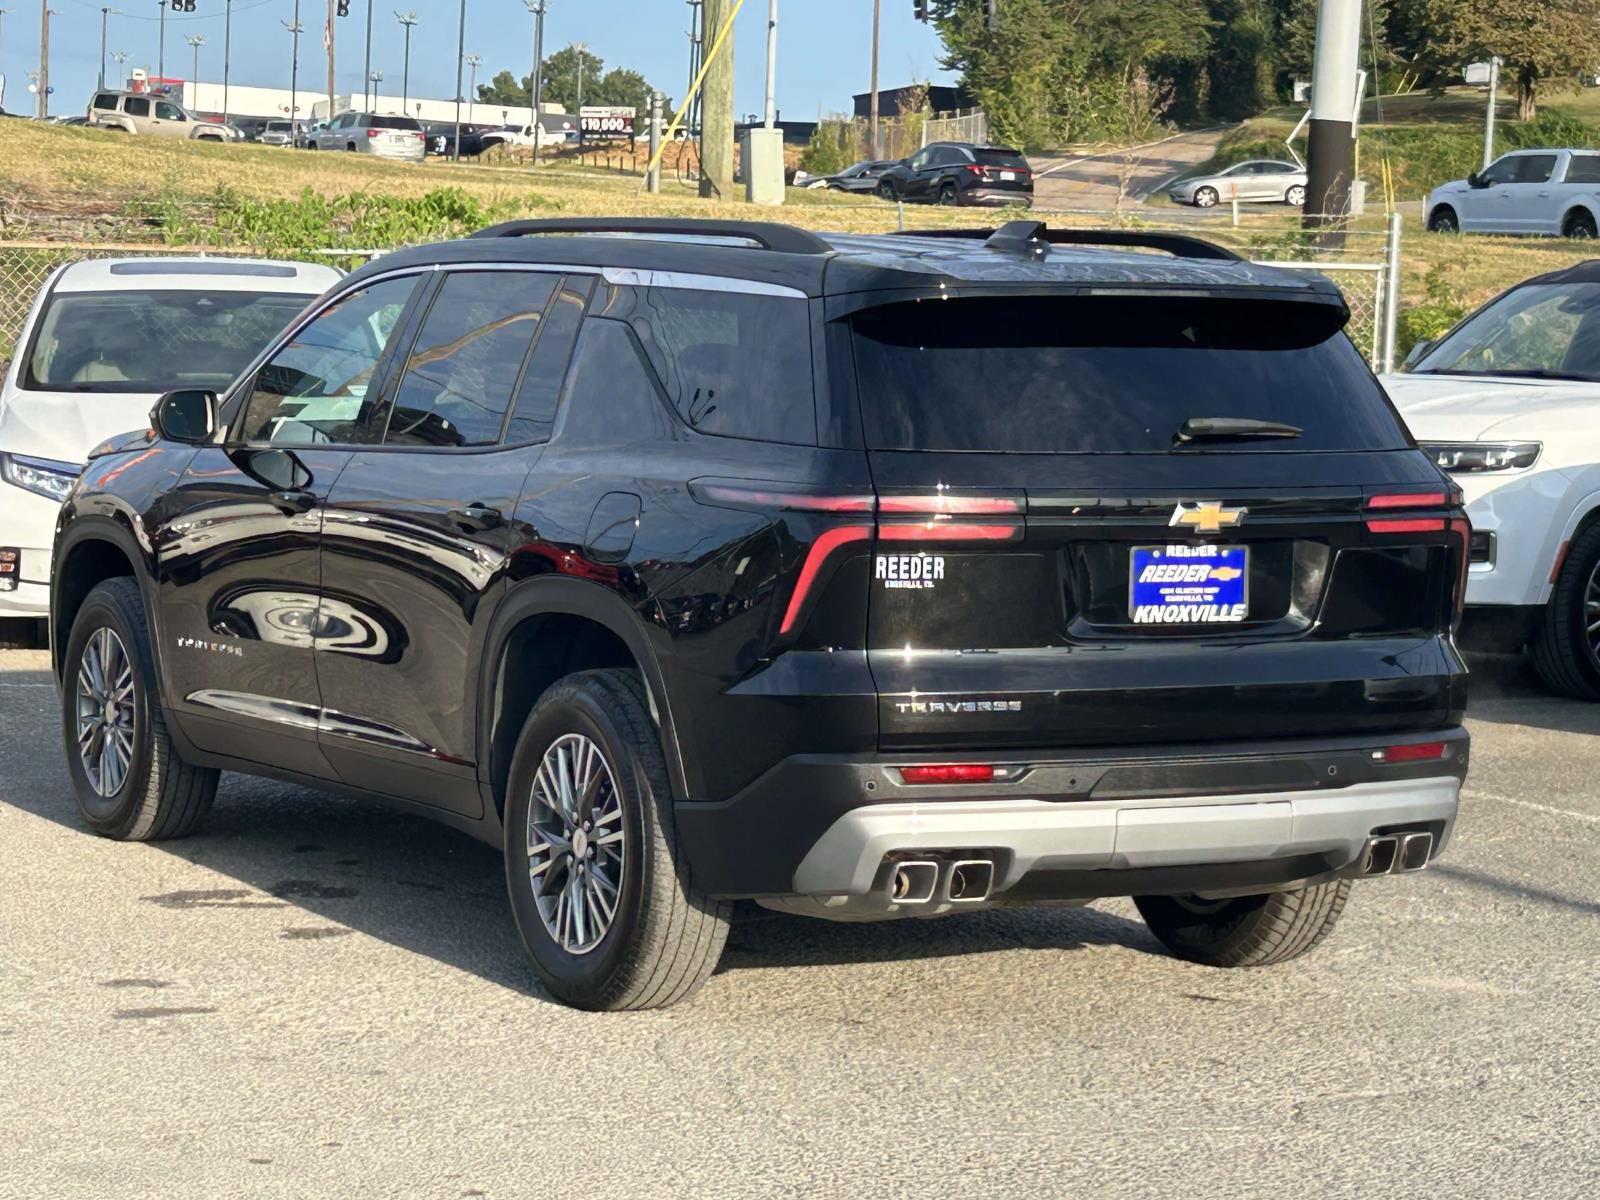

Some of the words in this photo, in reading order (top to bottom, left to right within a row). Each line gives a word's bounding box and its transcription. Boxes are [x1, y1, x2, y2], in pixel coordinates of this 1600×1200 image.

[875, 556, 945, 579] REEDER
[1139, 565, 1212, 583] REEDER
[1133, 604, 1247, 623] KNOXVILLE
[896, 701, 1022, 713] TRAVERSE
